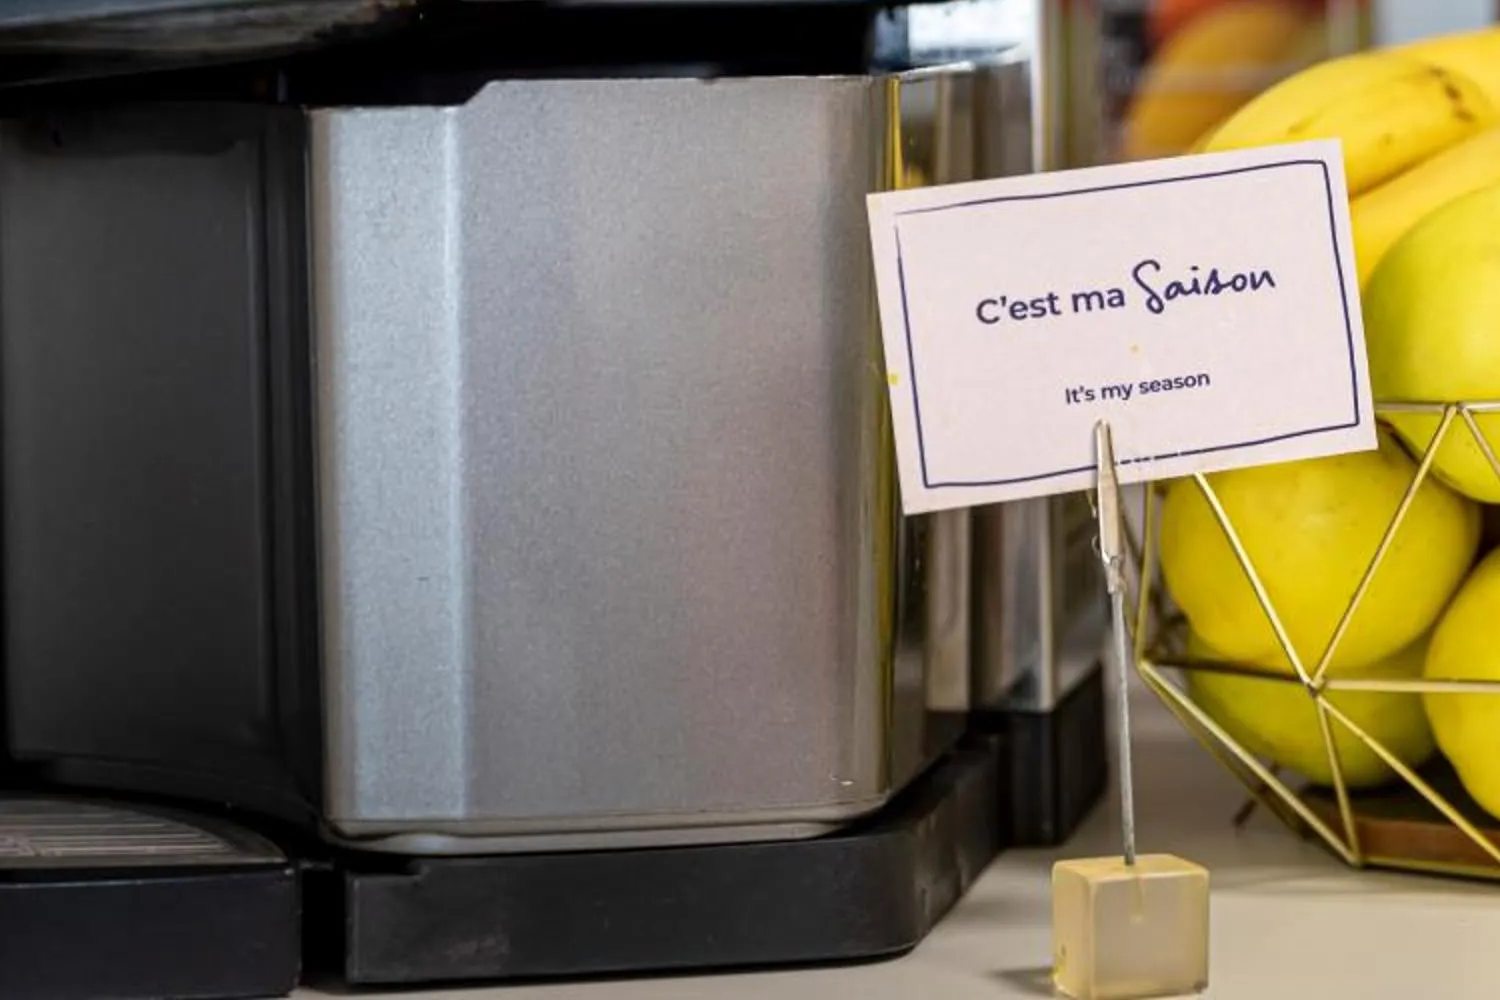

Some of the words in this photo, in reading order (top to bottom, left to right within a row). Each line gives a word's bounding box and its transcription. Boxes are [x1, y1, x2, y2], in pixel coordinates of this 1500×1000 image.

[976, 291, 1062, 324] C'est
[1072, 288, 1126, 313] ma
[1132, 260, 1276, 314] Saison
[1065, 386, 1096, 405] It's
[1101, 383, 1133, 401] my
[1139, 373, 1211, 395] season
